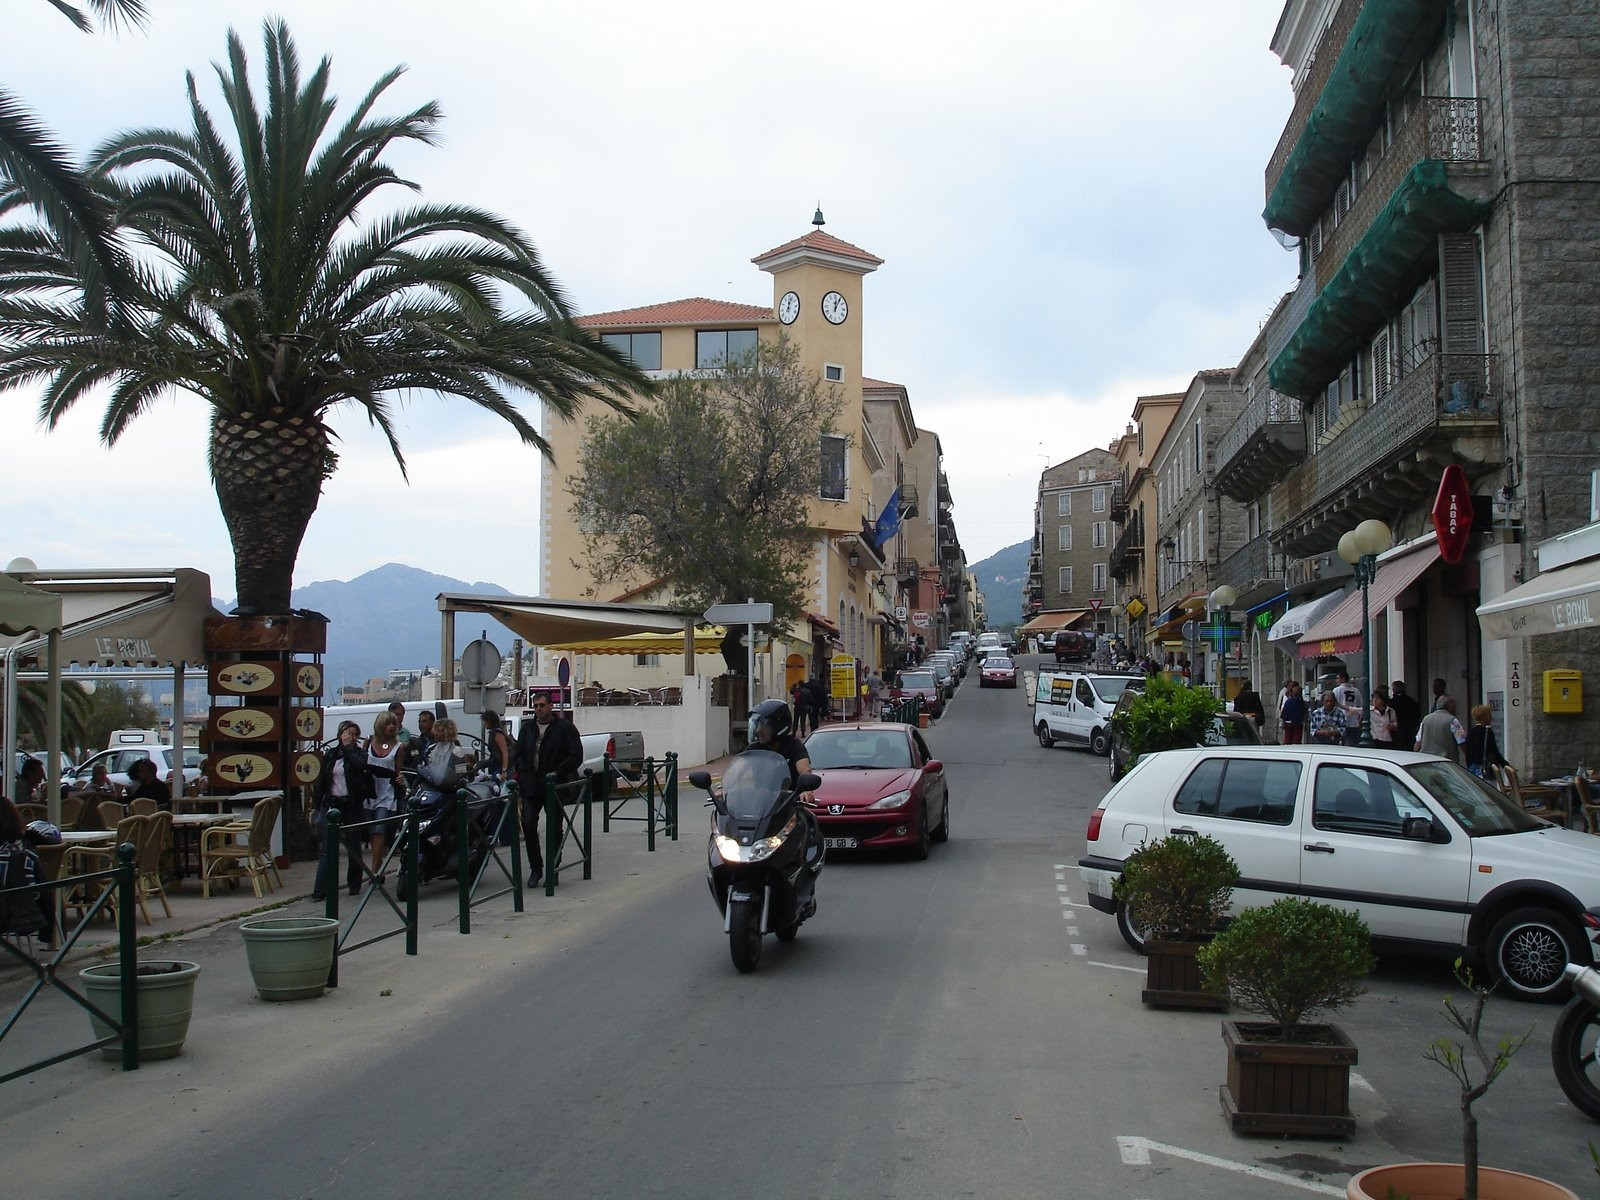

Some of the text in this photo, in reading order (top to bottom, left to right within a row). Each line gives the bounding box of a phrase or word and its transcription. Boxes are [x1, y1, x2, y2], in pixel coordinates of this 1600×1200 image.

[1449, 494, 1457, 535] TABAC
[1511, 598, 1594, 631] bar LE ROYAL
[94, 637, 157, 658] LE ROYAL
[1343, 690, 1355, 702] 15
